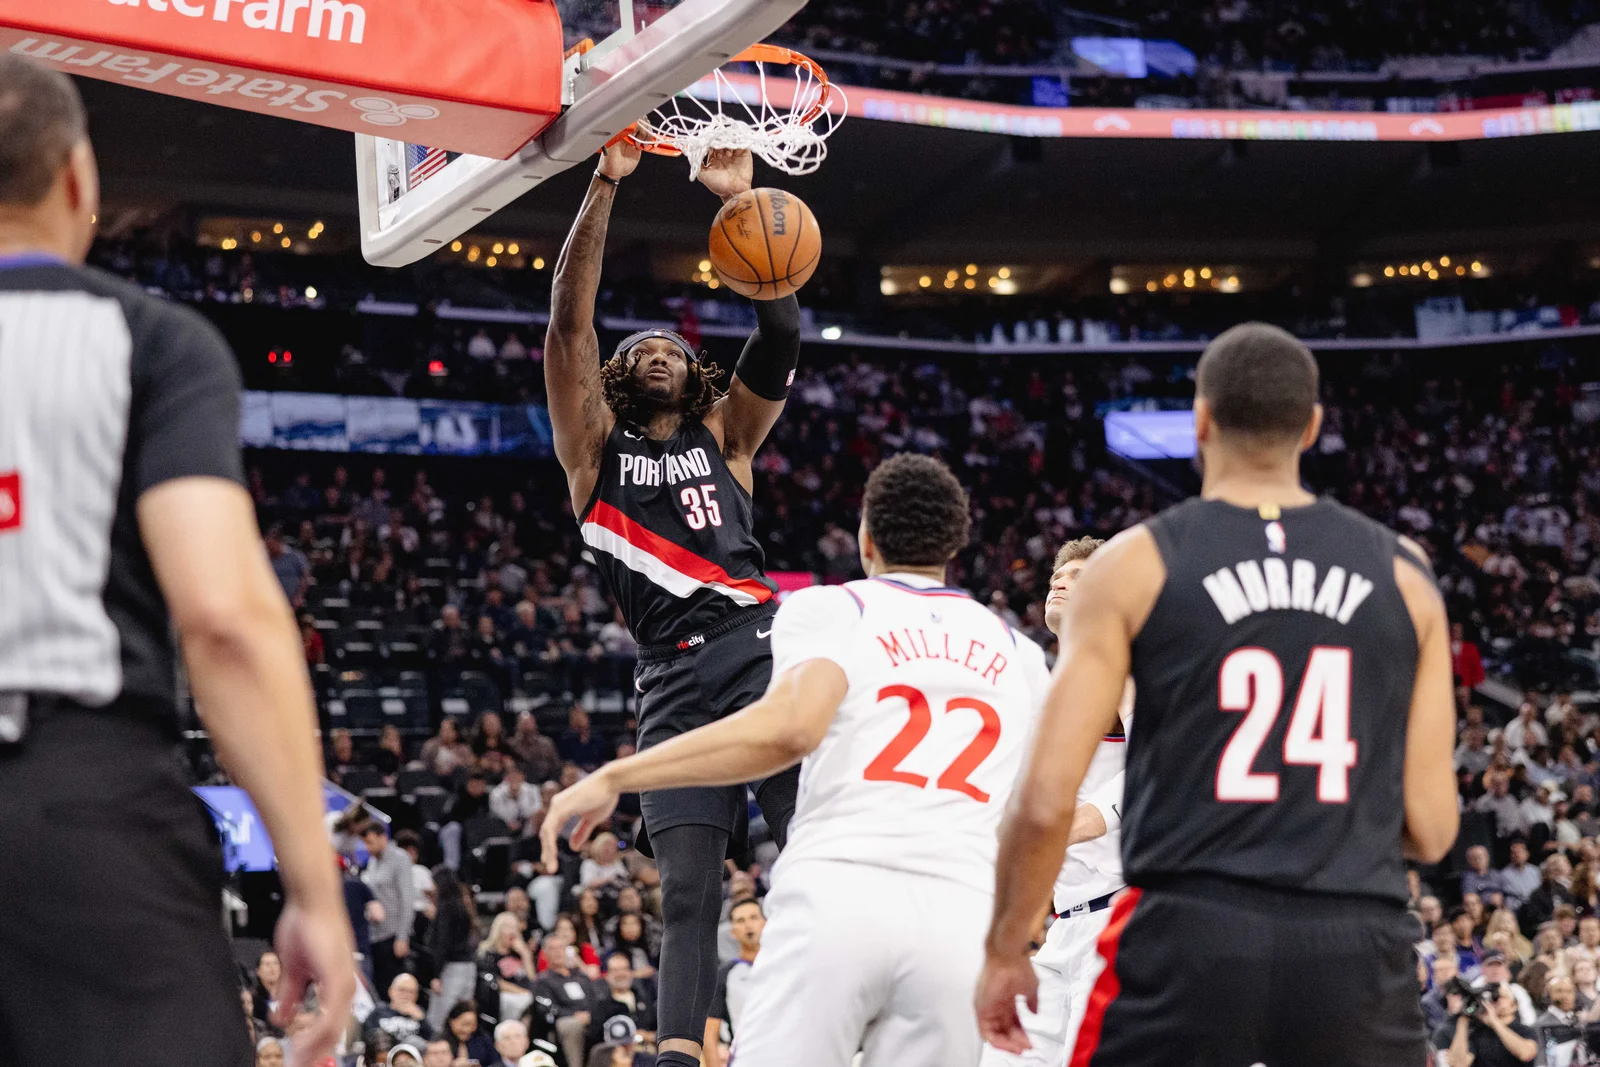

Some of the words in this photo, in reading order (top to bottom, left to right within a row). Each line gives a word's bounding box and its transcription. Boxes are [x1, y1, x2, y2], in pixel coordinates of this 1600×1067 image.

[680, 484, 722, 531] 35
[1202, 557, 1374, 625] MURRAY
[876, 628, 1008, 685] MILLER
[863, 683, 1002, 804] 22
[1214, 645, 1358, 804] 24
